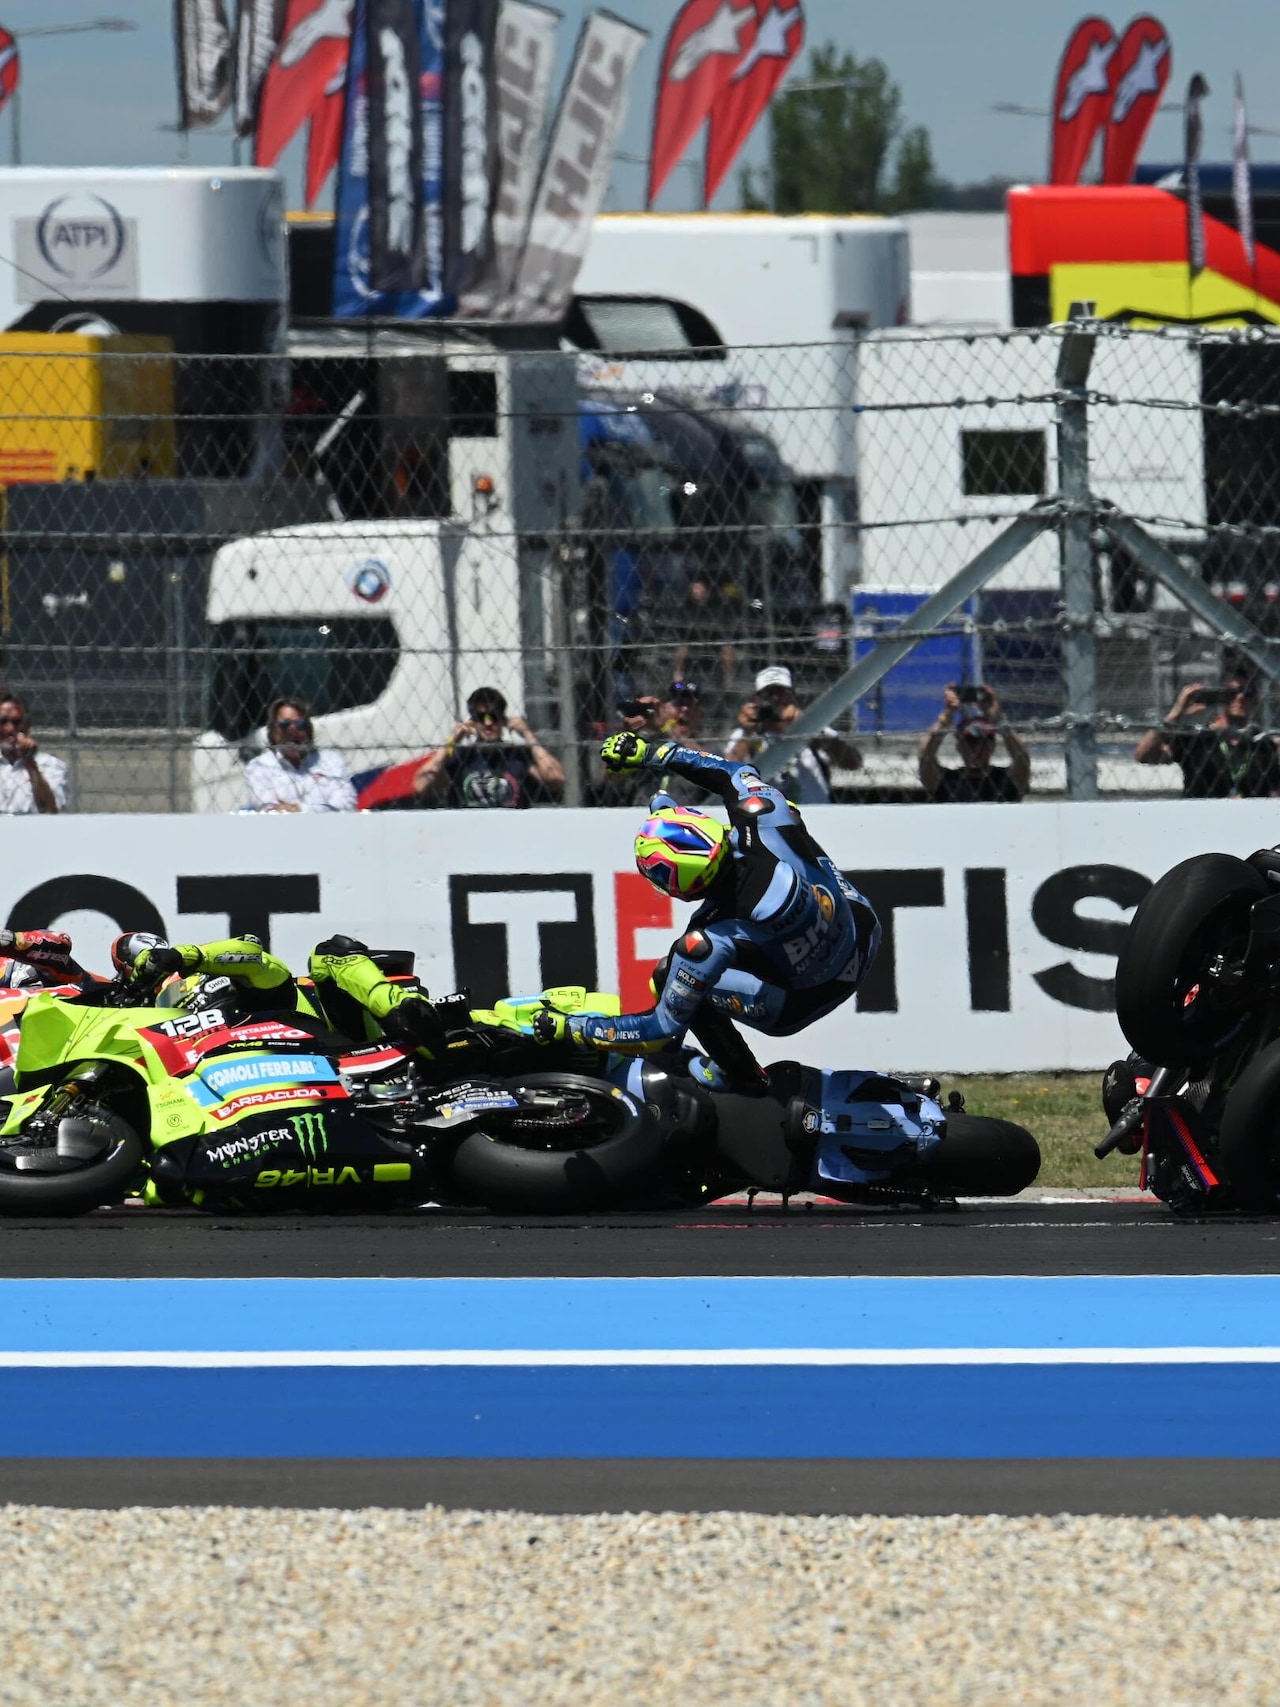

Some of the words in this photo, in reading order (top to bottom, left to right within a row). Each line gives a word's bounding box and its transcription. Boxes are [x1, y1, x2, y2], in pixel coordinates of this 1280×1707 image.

[546, 38, 624, 222] HJC
[54, 224, 108, 247] ATPI
[160, 1009, 226, 1038] 12B
[230, 1023, 286, 1038] PERTAMINA
[616, 1030, 641, 1040] NEWS
[207, 1064, 260, 1091] COMOLI
[261, 1061, 316, 1079] FERRARI
[218, 1088, 322, 1118] BARRACUDA
[206, 1127, 293, 1163] MONSTER
[222, 1141, 280, 1169] ENERGY
